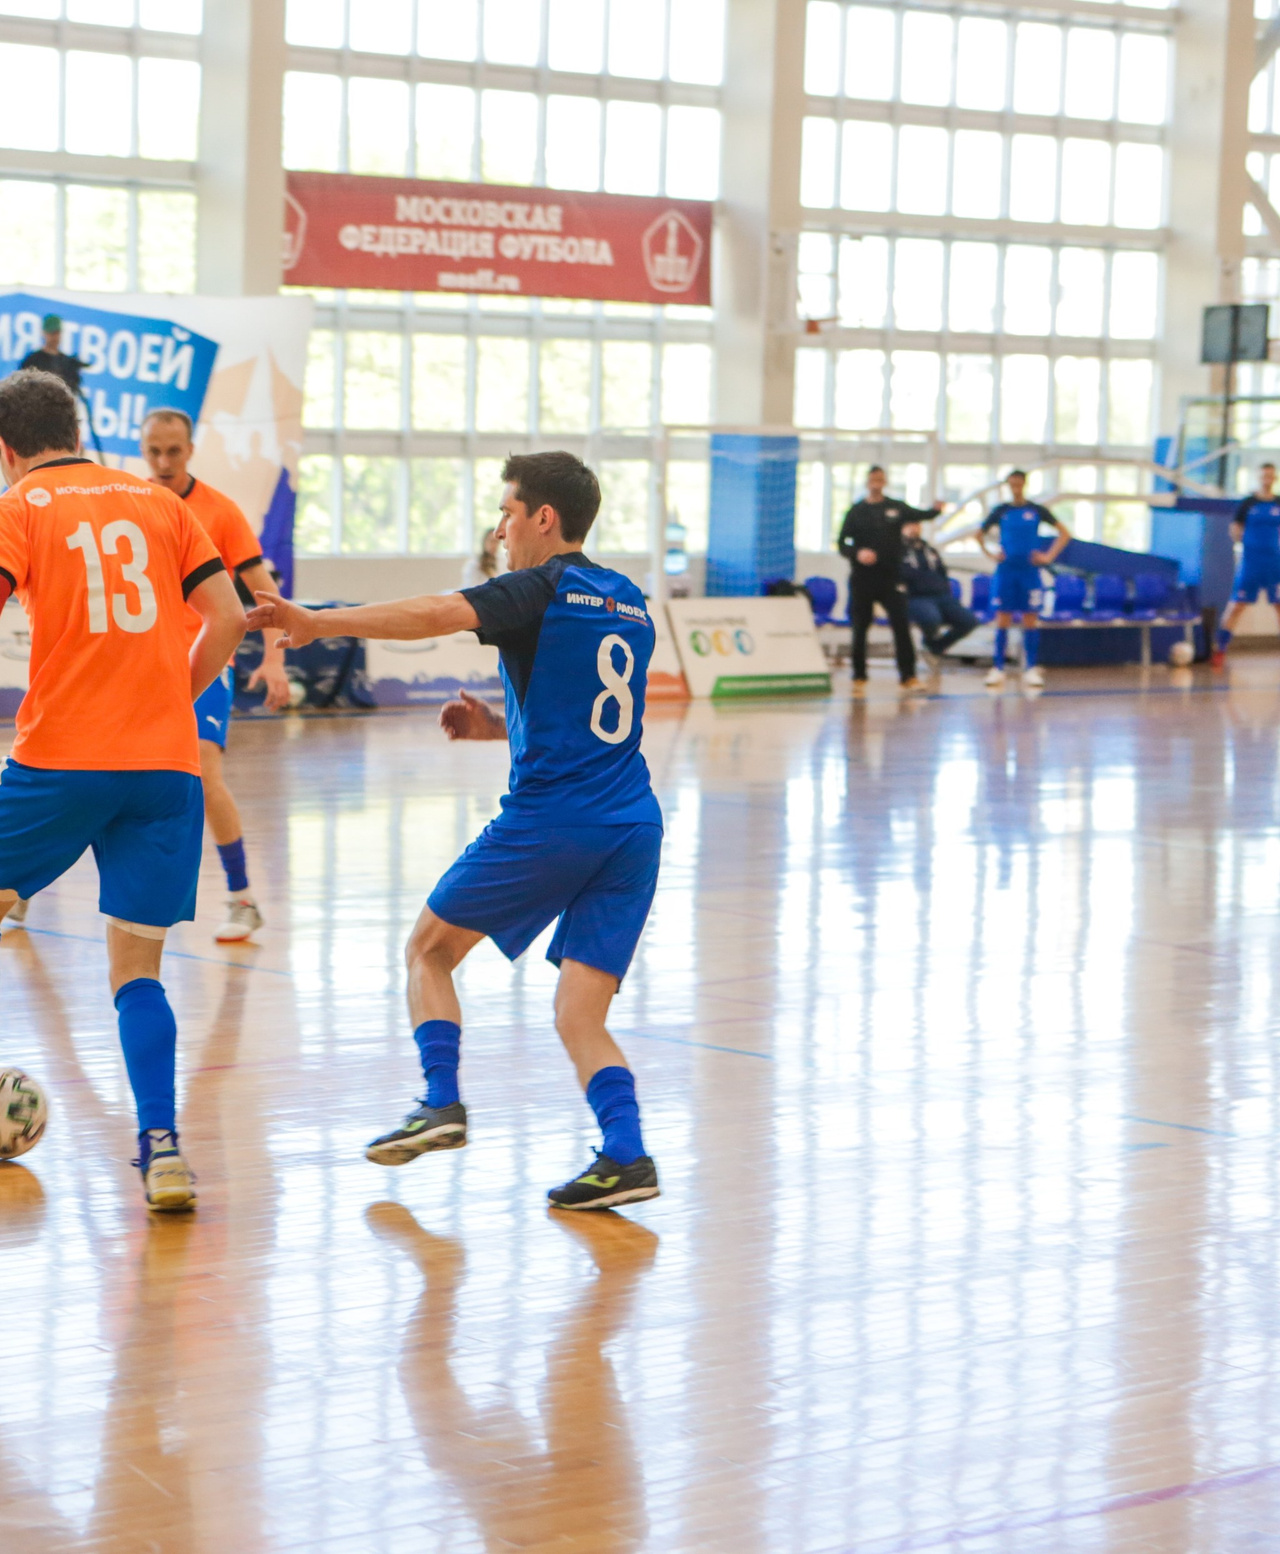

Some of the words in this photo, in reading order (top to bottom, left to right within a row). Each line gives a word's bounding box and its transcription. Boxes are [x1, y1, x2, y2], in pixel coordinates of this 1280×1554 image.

[395, 195, 563, 232] МОСКОВСКАЯ
[338, 224, 495, 261] ФЕДЕРАЦИЯ
[498, 230, 614, 266] ФУТБОЛА
[60, 319, 195, 391] ТВОЕЙ
[55, 482, 152, 496] МОСЭНЕРГОСБЫТ
[66, 519, 158, 634] 13
[566, 592, 604, 607] ИНТЕР
[590, 633, 635, 745] 8
